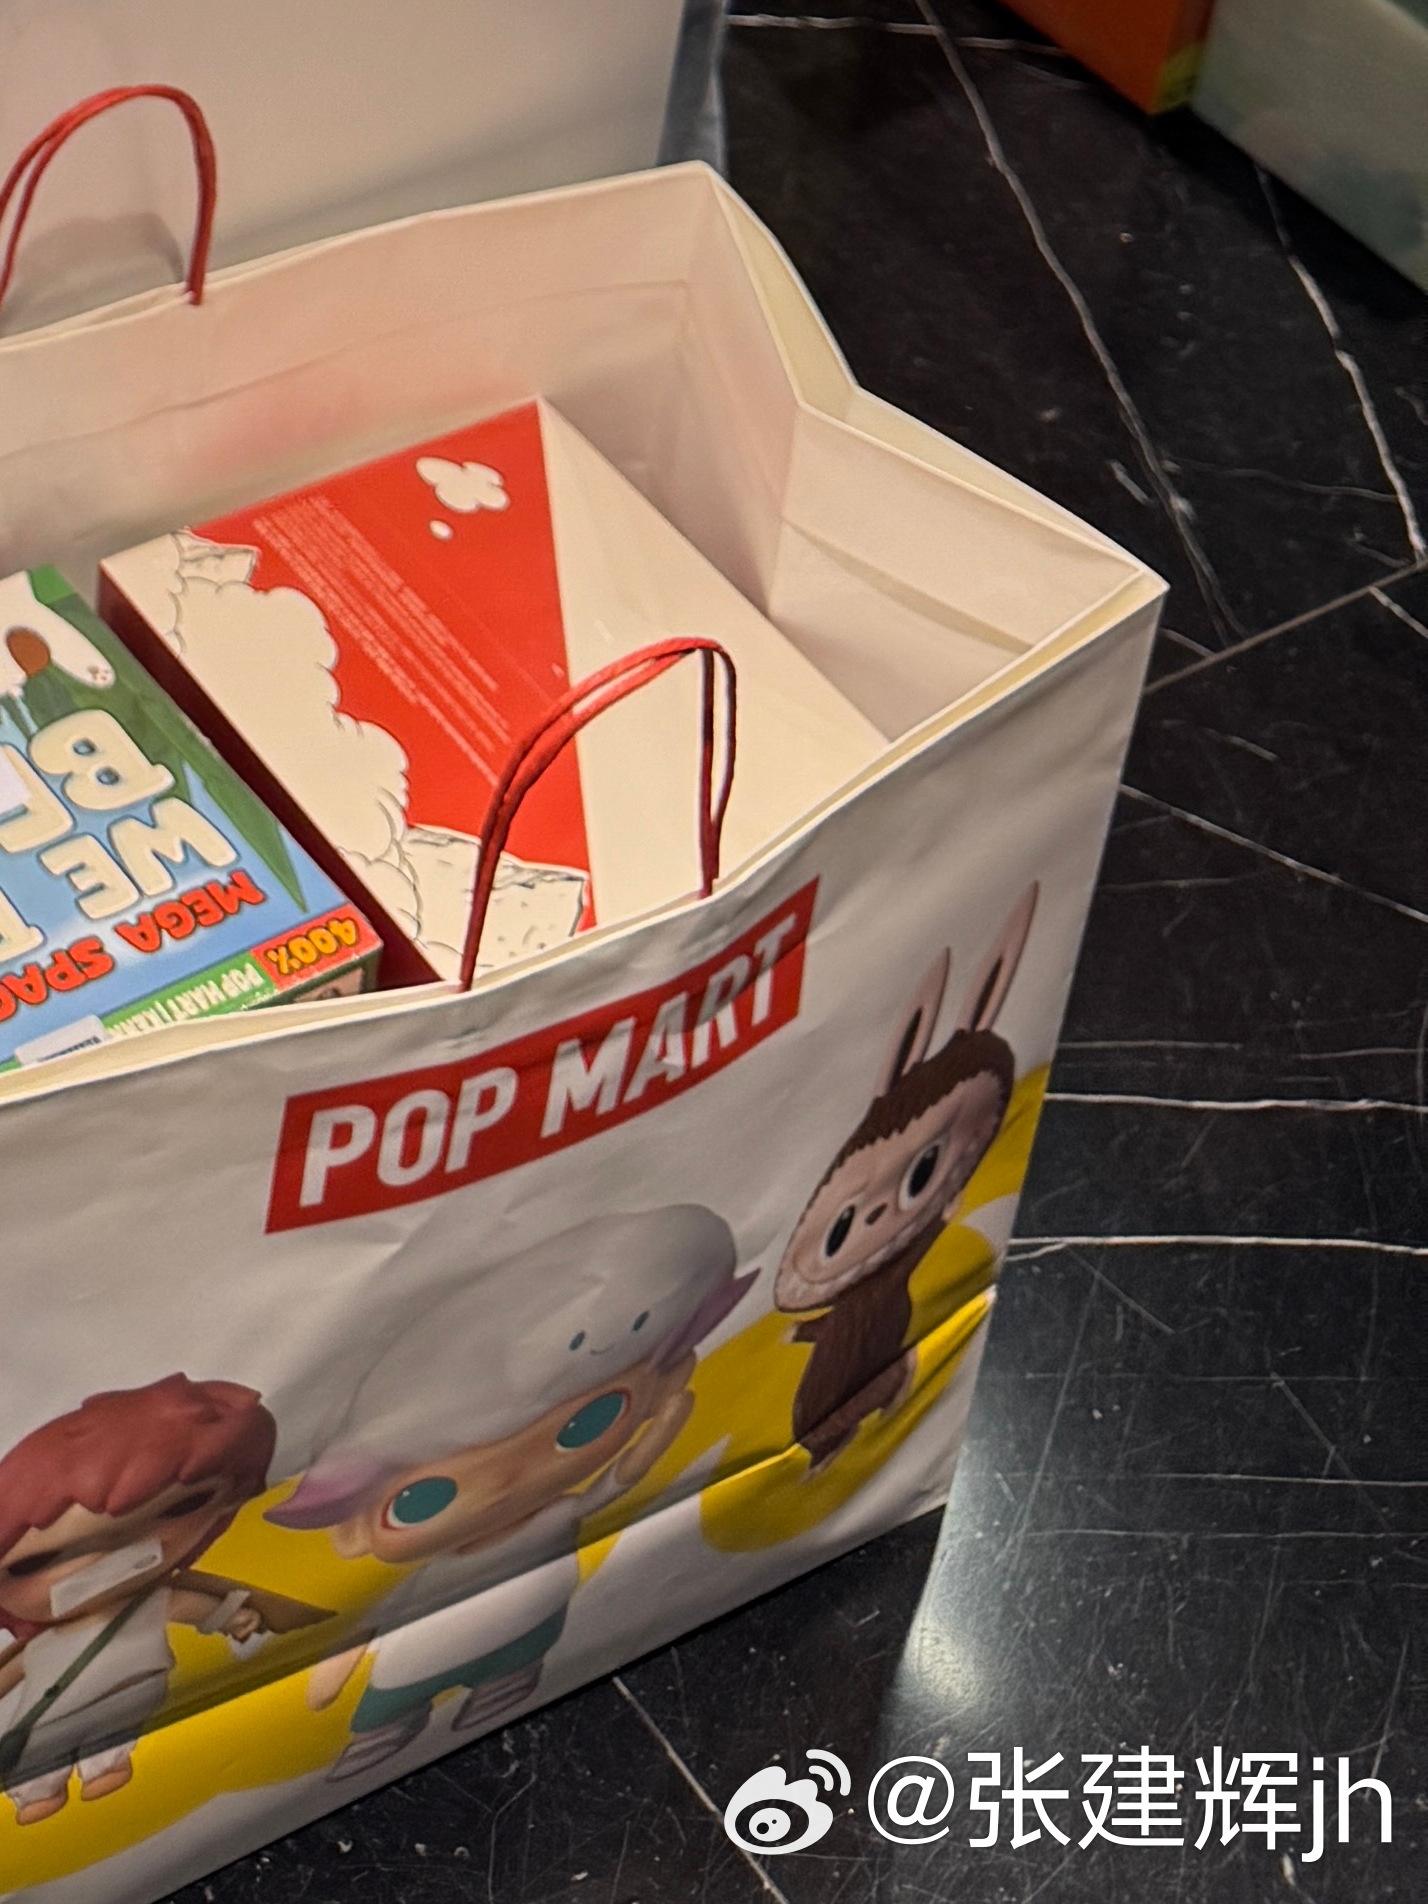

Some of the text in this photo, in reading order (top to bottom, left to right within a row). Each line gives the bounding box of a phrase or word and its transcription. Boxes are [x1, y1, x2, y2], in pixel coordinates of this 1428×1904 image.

[40, 795, 240, 921] WE
[114, 869, 267, 955] MEGA
[264, 916, 359, 976] 400%
[168, 979, 227, 1023] MART
[221, 961, 265, 998] POP
[298, 912, 798, 1209] POP MART
